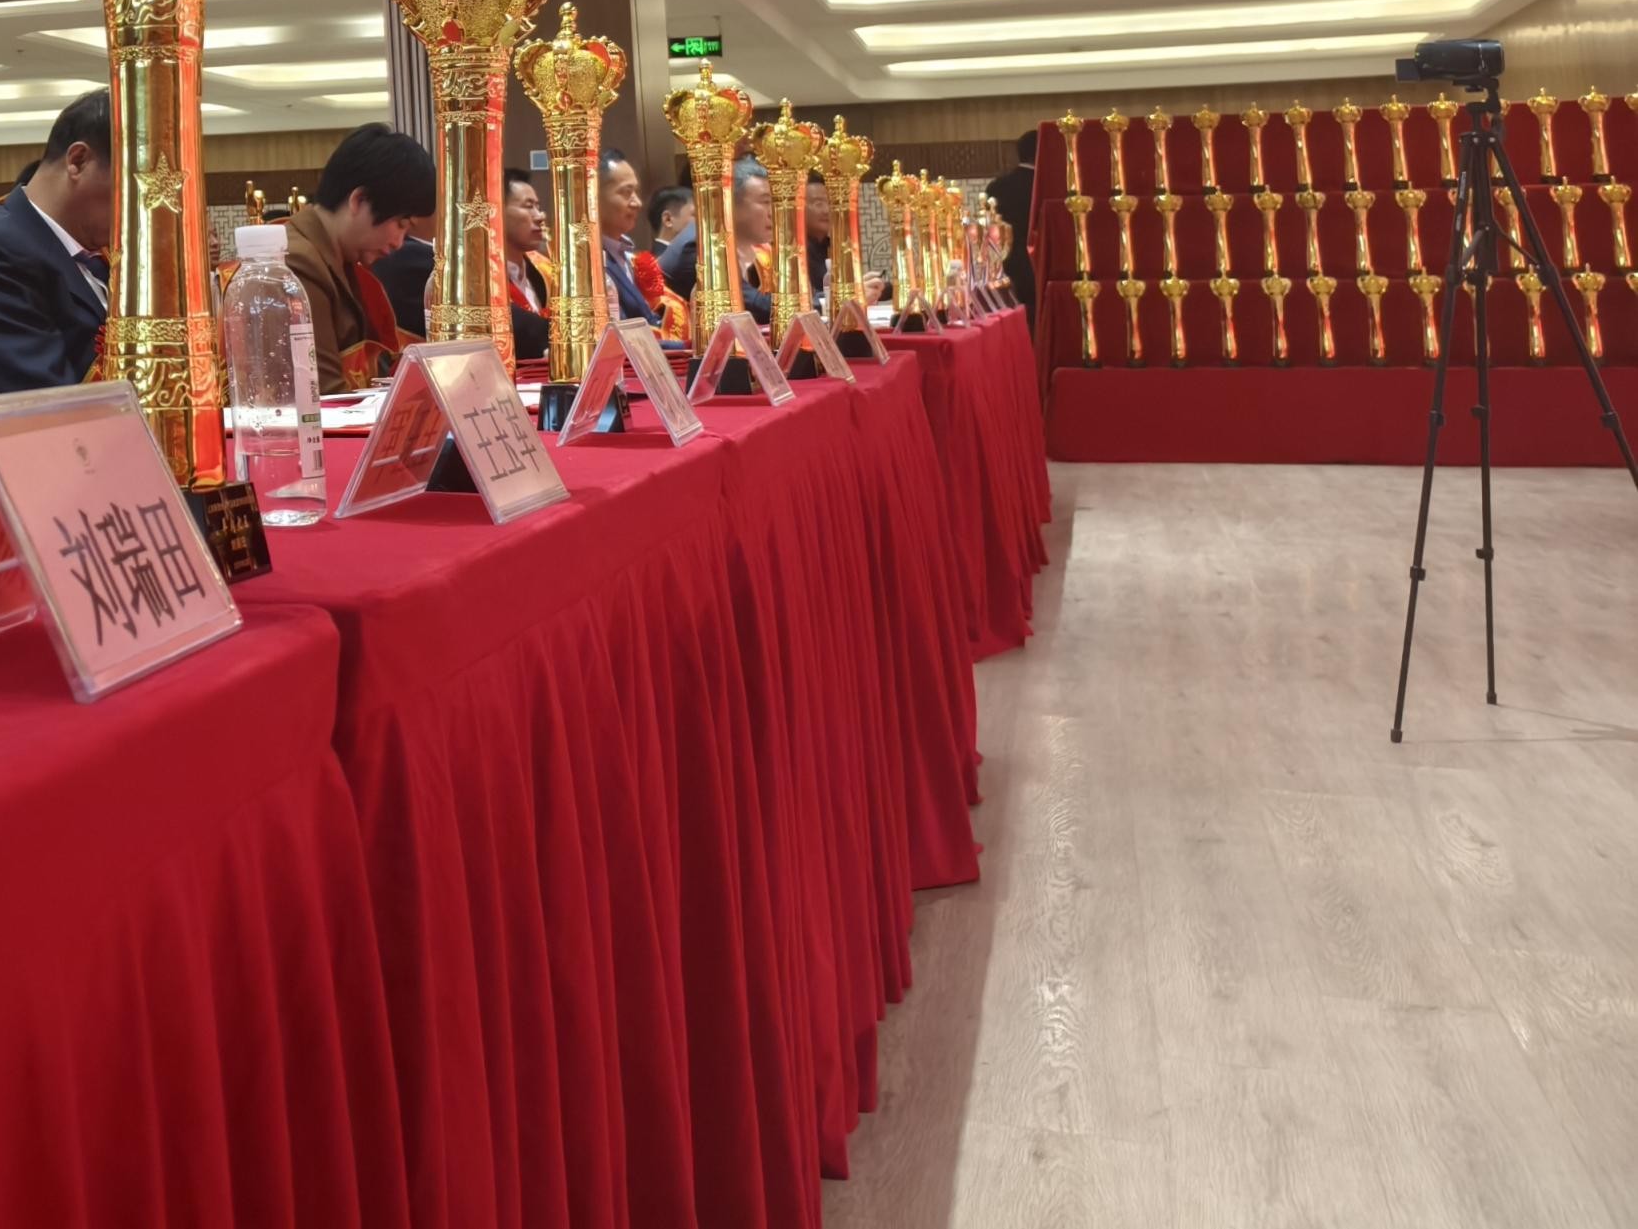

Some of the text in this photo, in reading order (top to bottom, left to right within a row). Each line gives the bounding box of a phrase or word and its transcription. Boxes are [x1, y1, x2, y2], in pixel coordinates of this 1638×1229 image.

[463, 396, 540, 482] 王玉军
[53, 496, 206, 647] 刘瑞田
